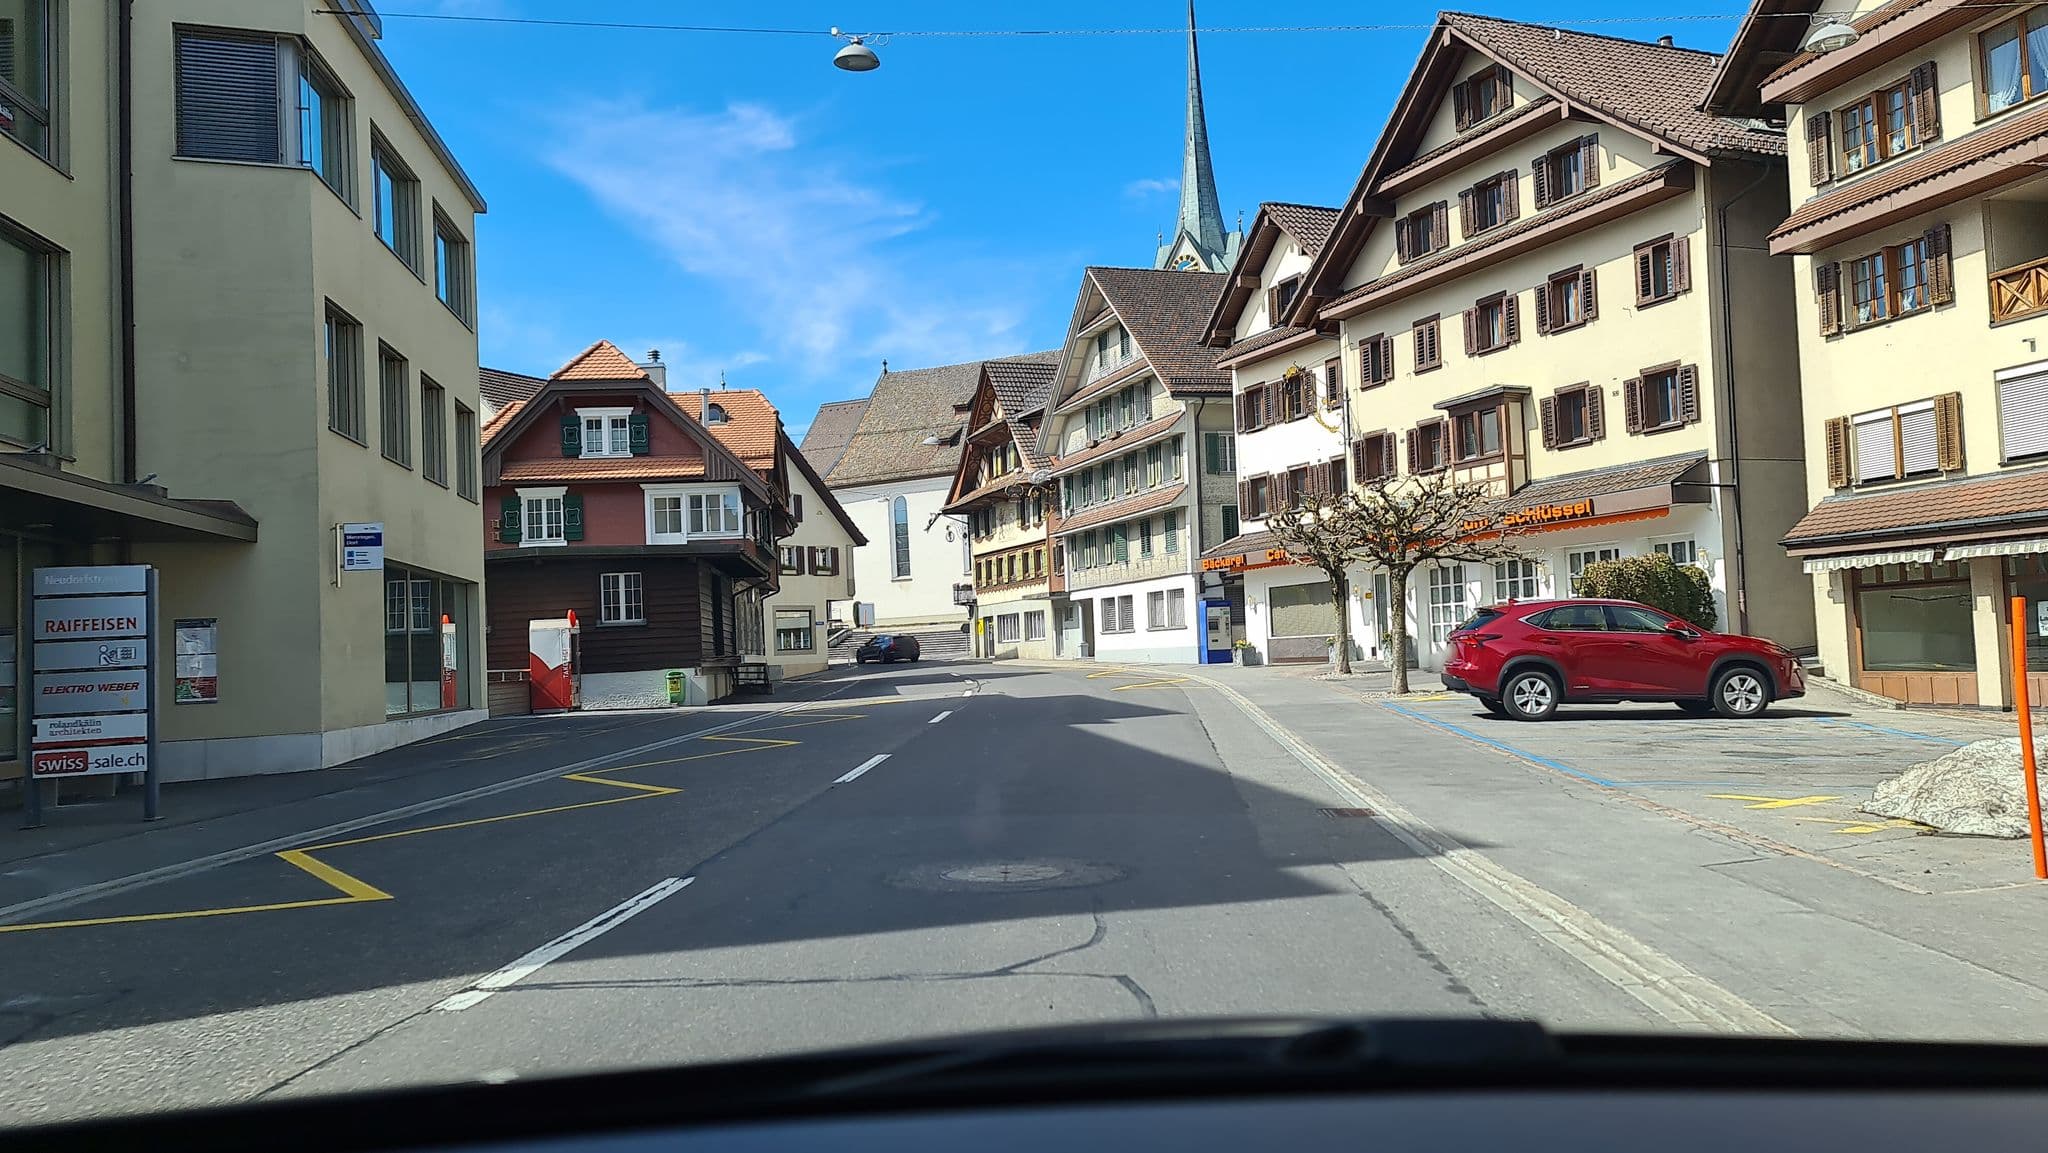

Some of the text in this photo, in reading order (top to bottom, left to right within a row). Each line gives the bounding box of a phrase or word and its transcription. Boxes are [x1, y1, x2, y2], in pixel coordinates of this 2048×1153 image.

[1503, 498, 1592, 525] Schlüssel
[1265, 548, 1290, 562] Caf
[45, 617, 137, 633] RAIFFEISEN
[42, 682, 139, 695] ELEKTRO WEBER
[48, 727, 102, 737] architekten
[37, 752, 145, 772] swiss-sale.ch
